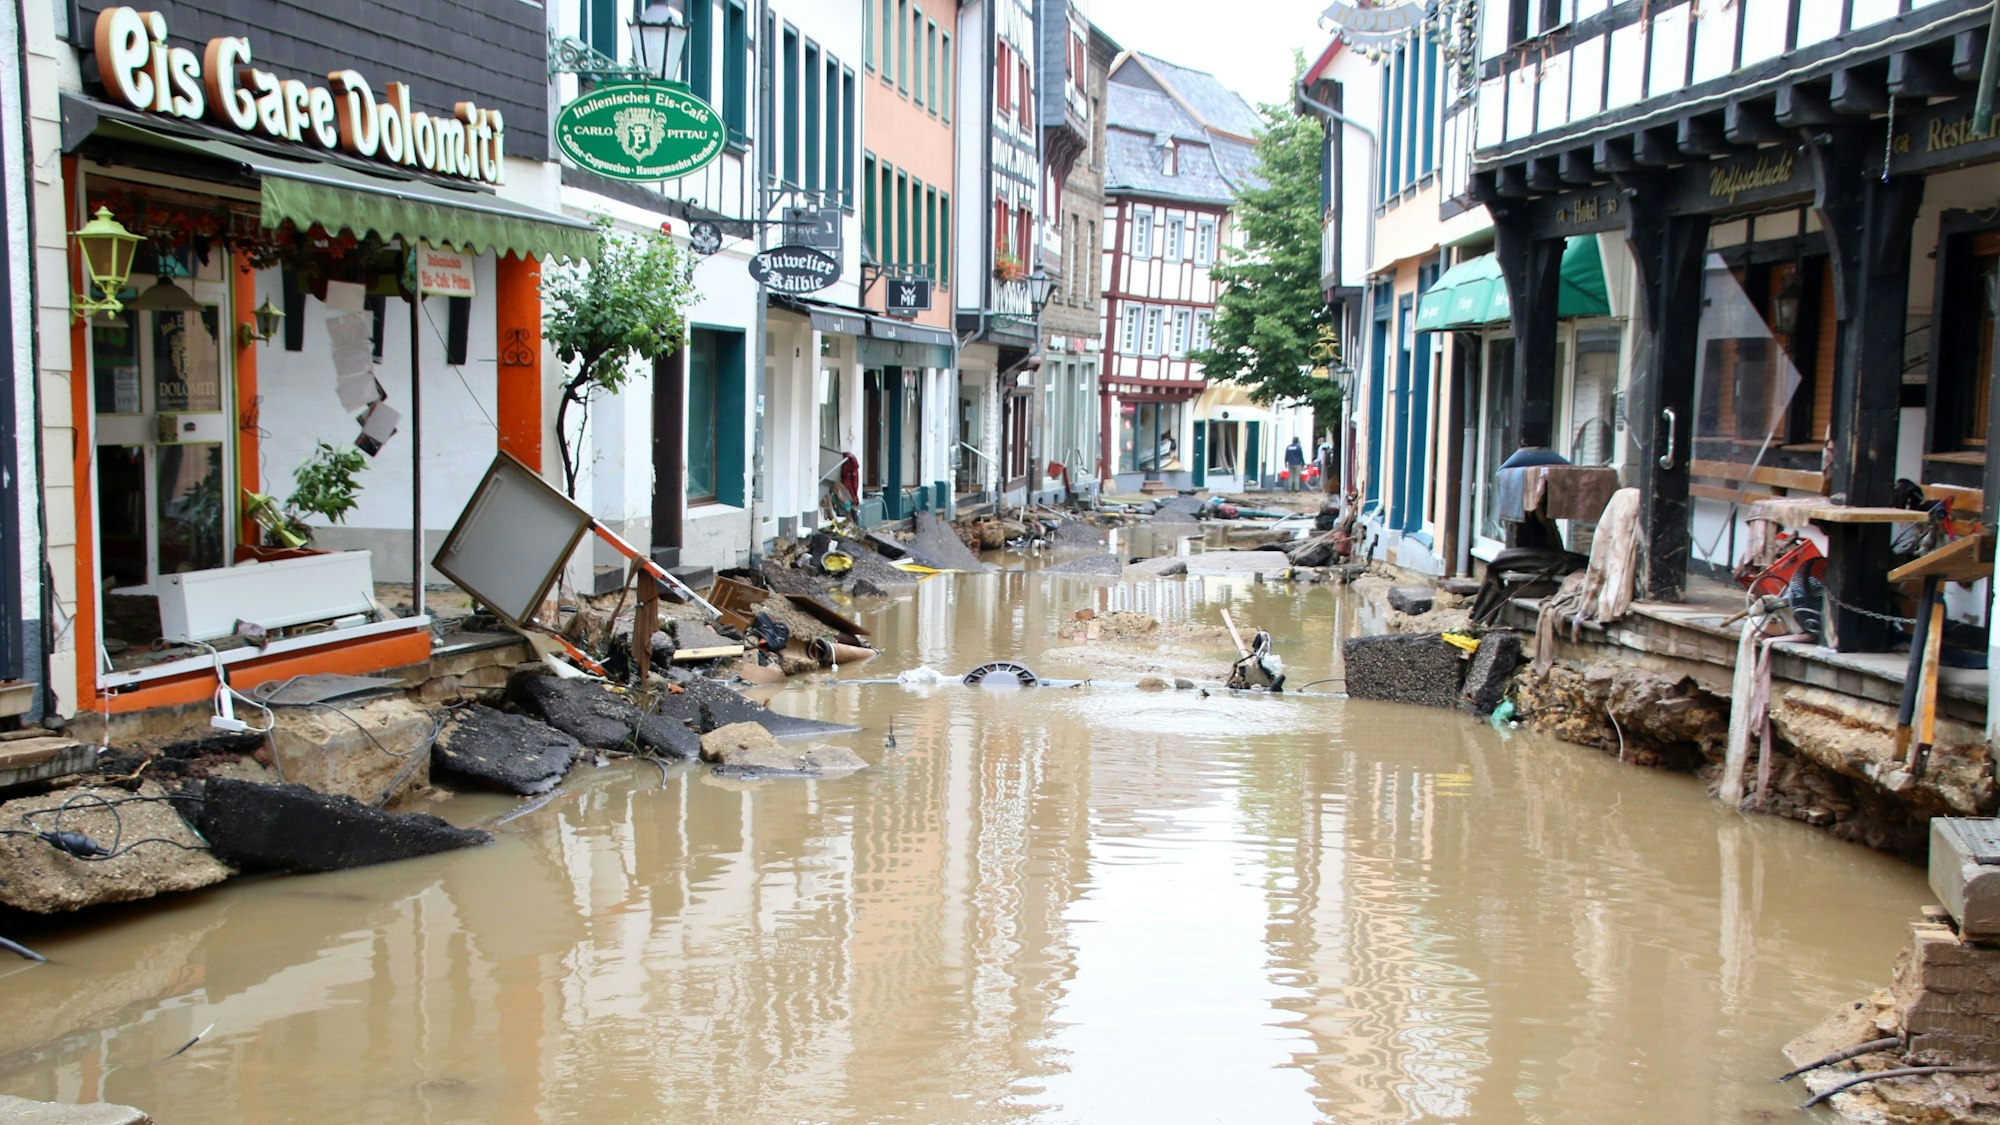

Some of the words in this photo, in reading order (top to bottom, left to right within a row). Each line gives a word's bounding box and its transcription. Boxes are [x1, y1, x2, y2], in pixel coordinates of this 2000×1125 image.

[1334, 8, 1414, 30] HOTEL
[572, 91, 650, 119] Italienisches
[329, 69, 505, 186] Dolomiti
[573, 125, 613, 137] CARLO
[667, 129, 708, 139] PITTAU
[636, 159, 691, 176] Hausgemachte
[690, 139, 718, 165] Kuchen
[1709, 151, 1794, 204] Wolfsschlucht
[1573, 196, 1598, 224] Hotel
[757, 253, 834, 275] Juwelier
[763, 270, 824, 292] Kälble
